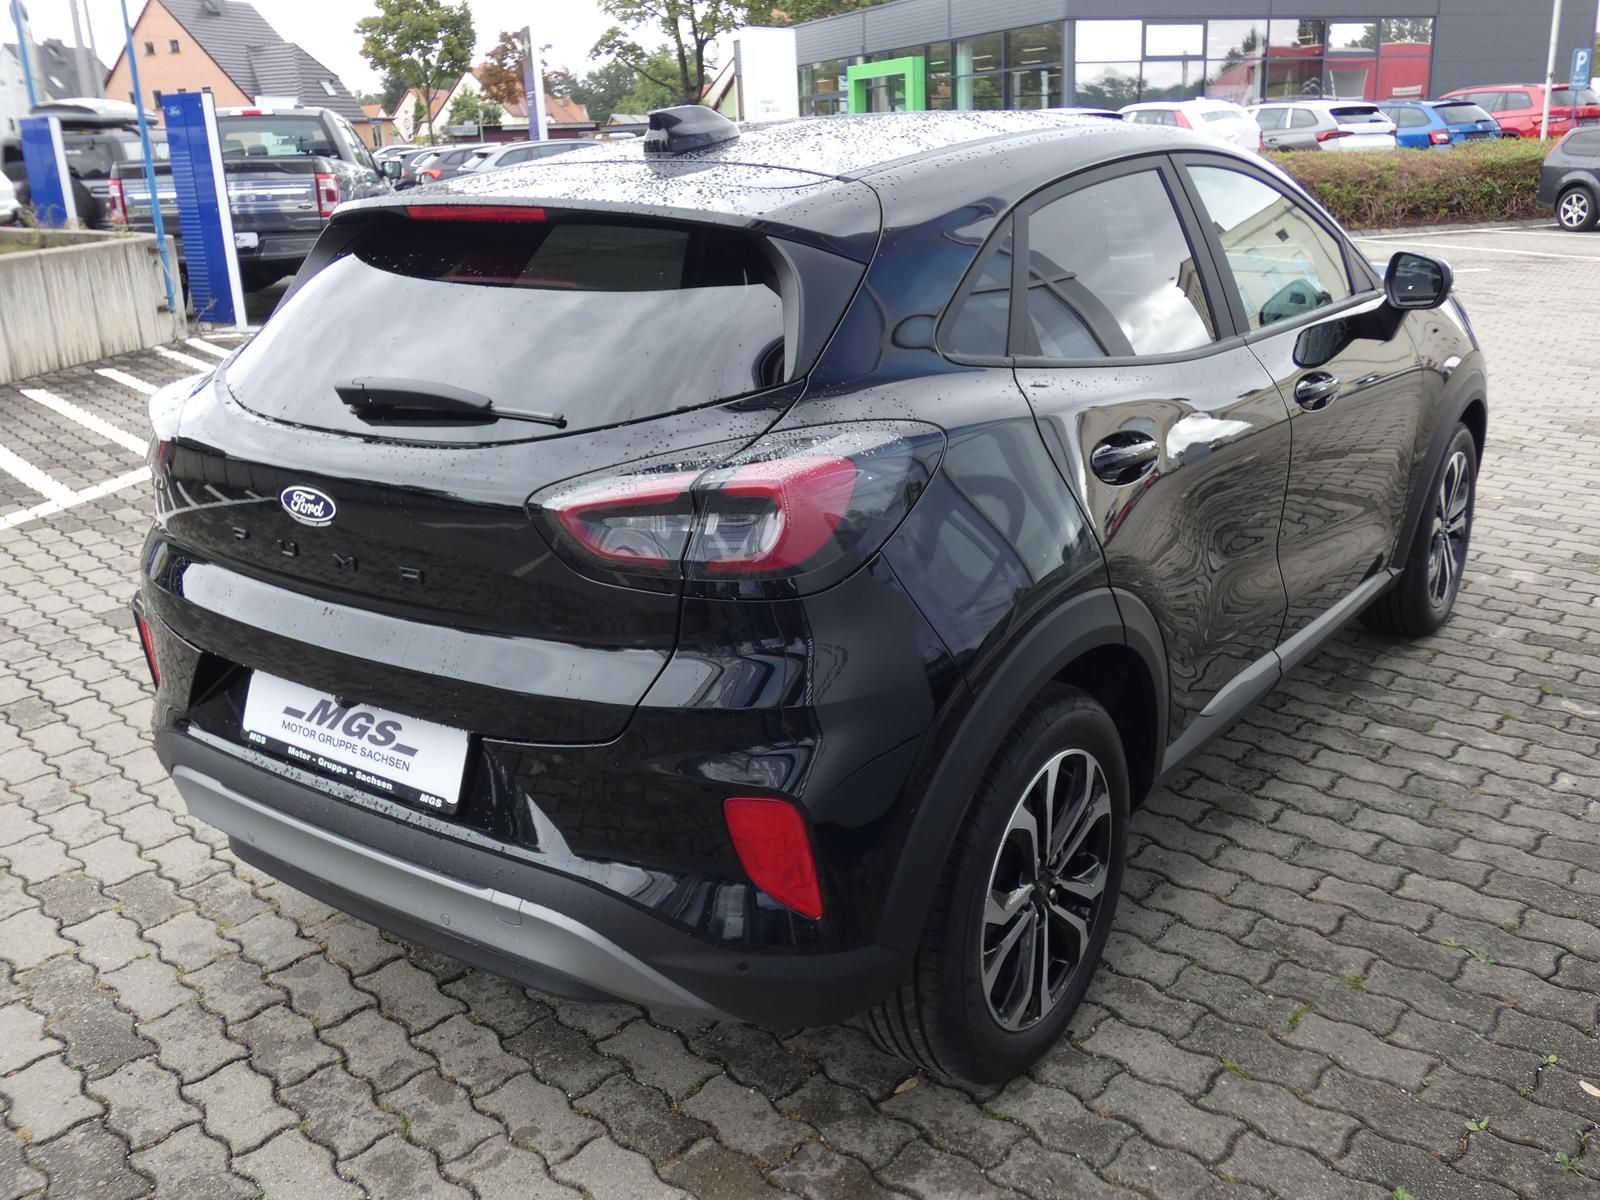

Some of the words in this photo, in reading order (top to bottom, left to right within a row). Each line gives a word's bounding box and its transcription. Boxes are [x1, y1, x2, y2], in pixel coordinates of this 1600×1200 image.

[1575, 51, 1588, 72] P
[290, 490, 324, 517] Ford
[305, 699, 403, 747] MGS
[248, 732, 266, 744] MGS
[281, 720, 317, 740] MOTOR
[318, 734, 358, 754] GRUPPE
[360, 746, 411, 772] SACHSEN
[287, 746, 311, 761] Motor
[317, 757, 347, 774] Gruppe
[355, 770, 393, 791] Sachsen
[419, 793, 442, 808] MGS
